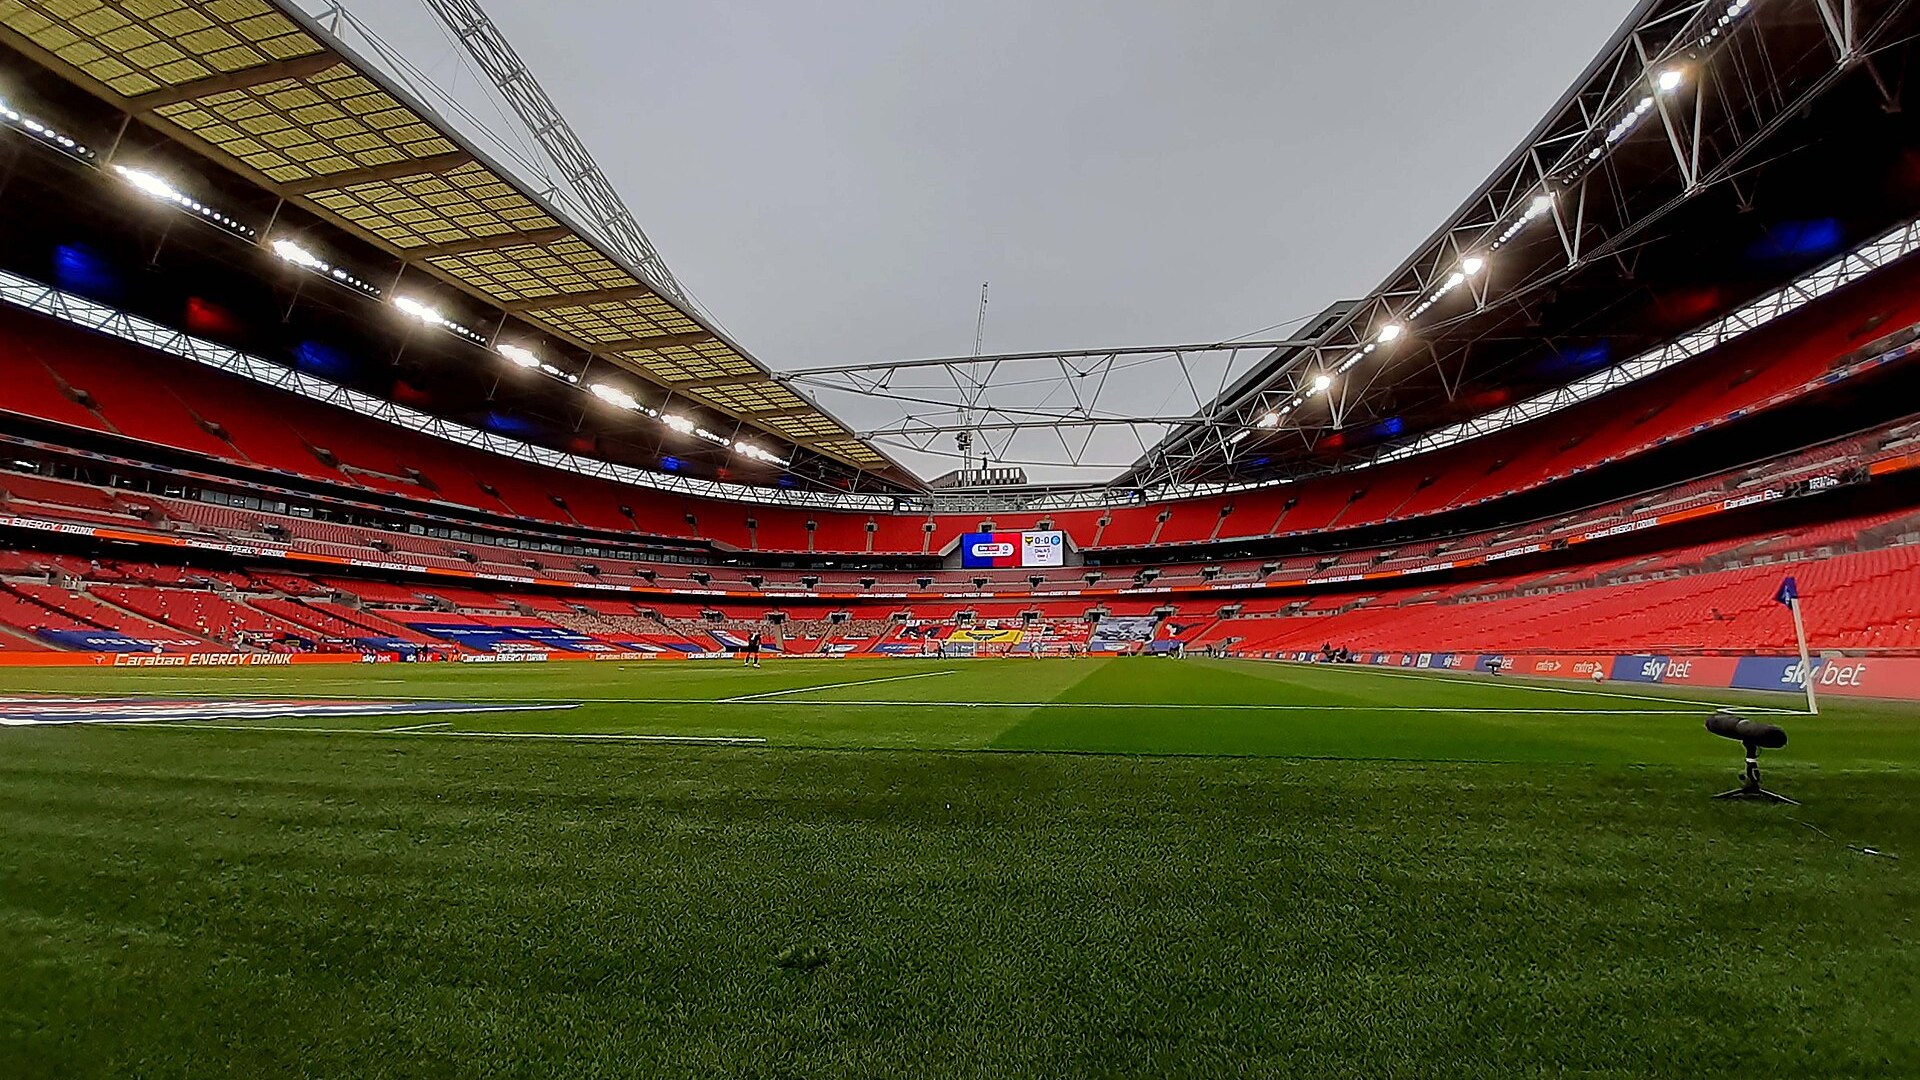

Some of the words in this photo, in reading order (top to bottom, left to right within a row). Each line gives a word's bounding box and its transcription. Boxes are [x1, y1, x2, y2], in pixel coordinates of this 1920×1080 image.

[1723, 493, 1762, 510] Carabao
[13, 518, 60, 531] ENERGY
[60, 524, 96, 536] DRINK
[113, 653, 186, 666] Carabao
[188, 653, 250, 665] ENERGY
[250, 653, 292, 665] DRINK
[362, 654, 376, 664] sky
[377, 653, 391, 663] bet
[460, 654, 495, 663] Carabao
[496, 653, 526, 662] ENERGY
[1641, 658, 1665, 680] sky
[1665, 659, 1692, 678] bet
[1781, 660, 1819, 688] sky
[1820, 660, 1866, 687] bet
